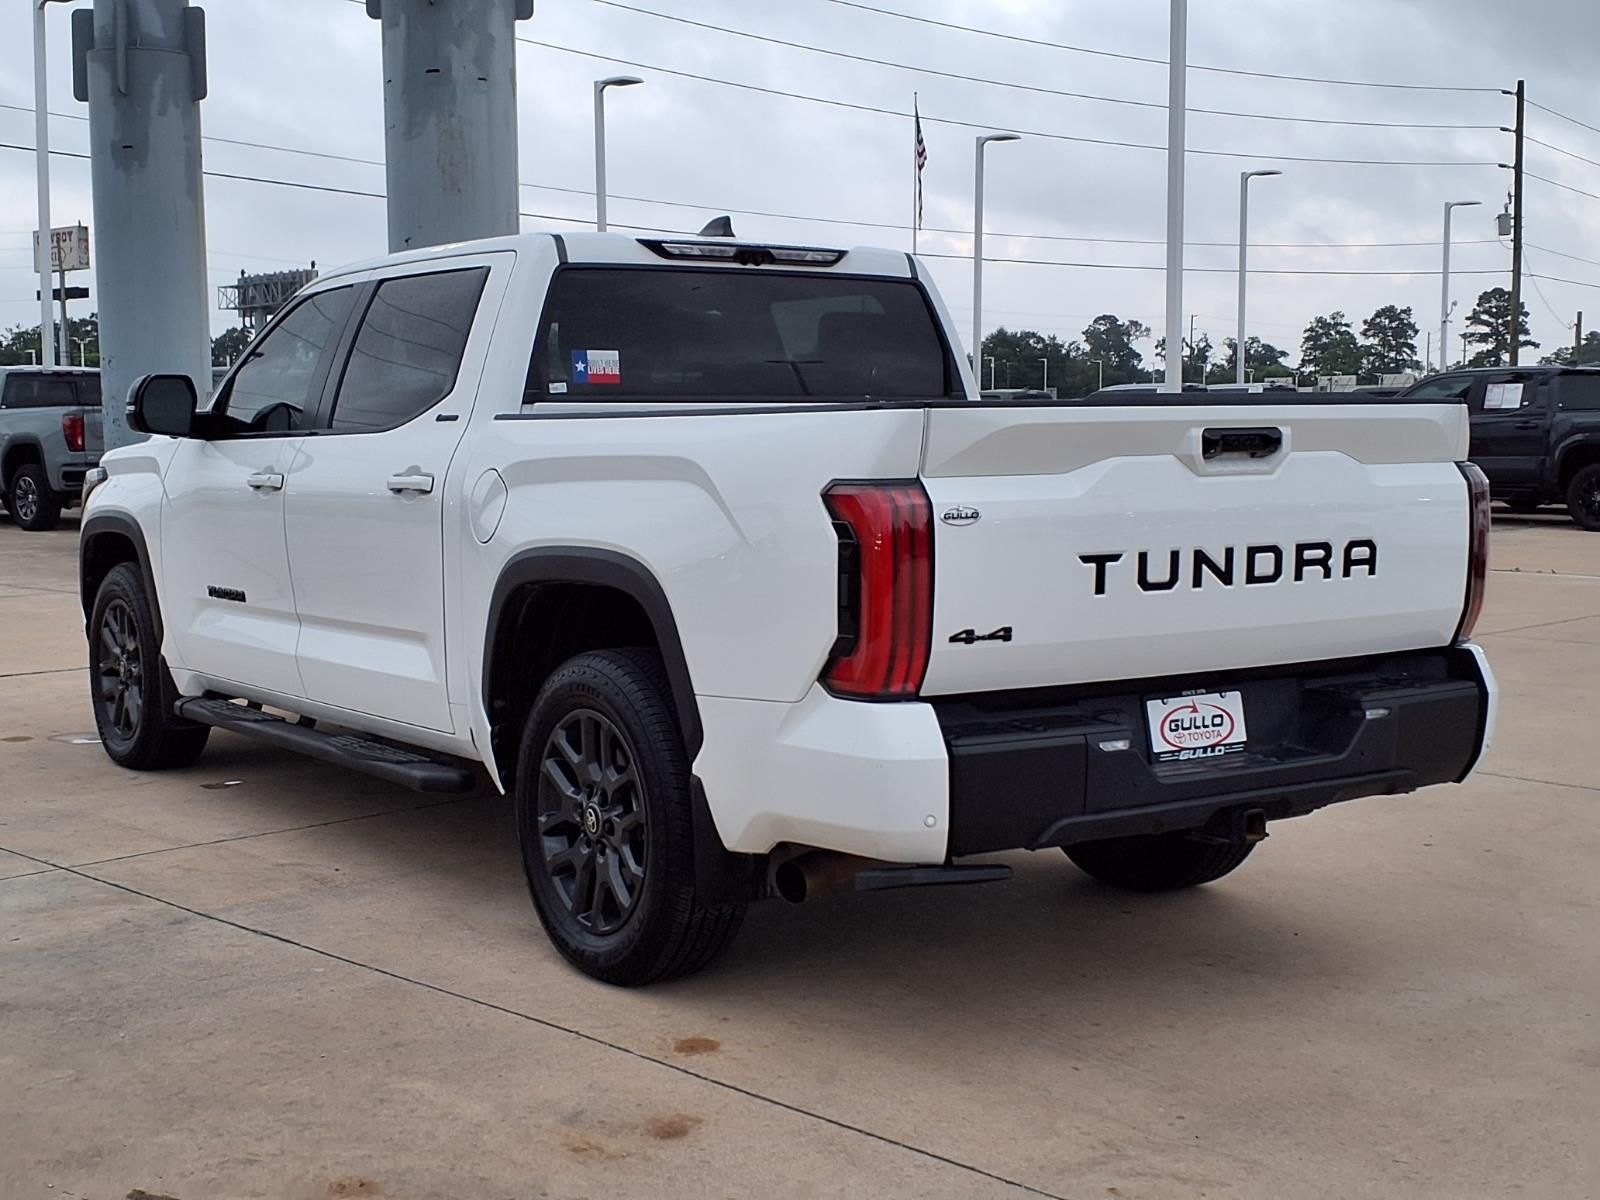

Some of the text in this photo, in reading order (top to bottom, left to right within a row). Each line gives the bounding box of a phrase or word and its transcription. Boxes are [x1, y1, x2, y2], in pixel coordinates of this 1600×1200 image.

[943, 511, 980, 520] GULLO
[1077, 538, 1377, 596] TUNDRA
[1168, 713, 1224, 733] GULLO
[1187, 729, 1223, 742] TOYOTA
[1178, 745, 1225, 760] GULLO
